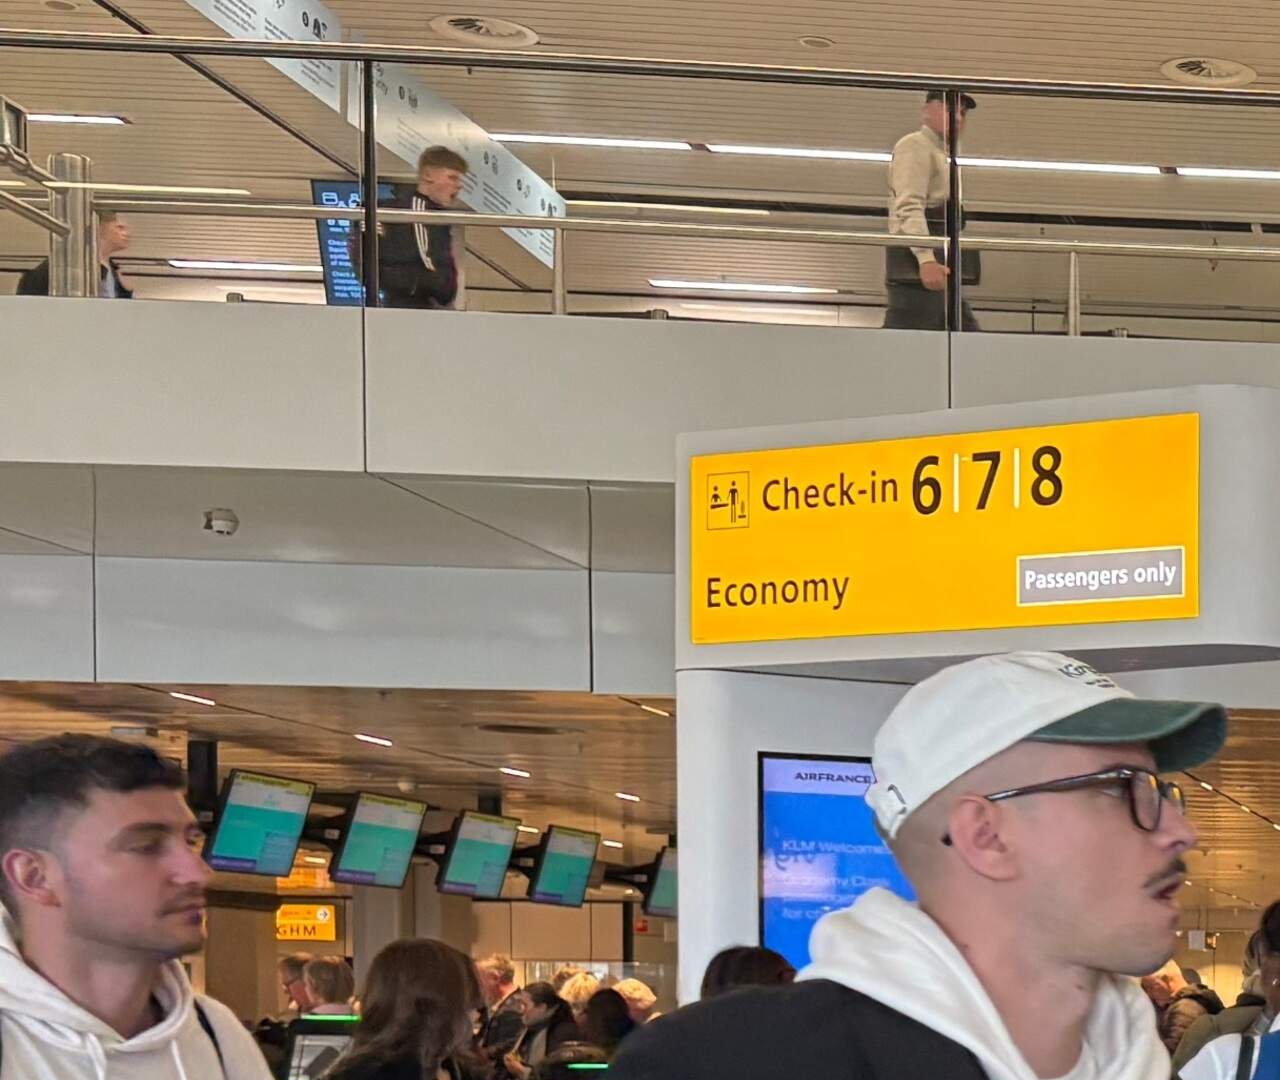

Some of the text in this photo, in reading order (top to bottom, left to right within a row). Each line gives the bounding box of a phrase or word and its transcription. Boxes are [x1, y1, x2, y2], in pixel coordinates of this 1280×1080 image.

[762, 446, 1063, 515] Check-in 6 7 8
[1025, 560, 1176, 591] Passengers only
[707, 577, 849, 610] Economy
[795, 772, 872, 784] AIRFRANCE
[290, 924, 300, 937] H
[303, 924, 317, 937] M
